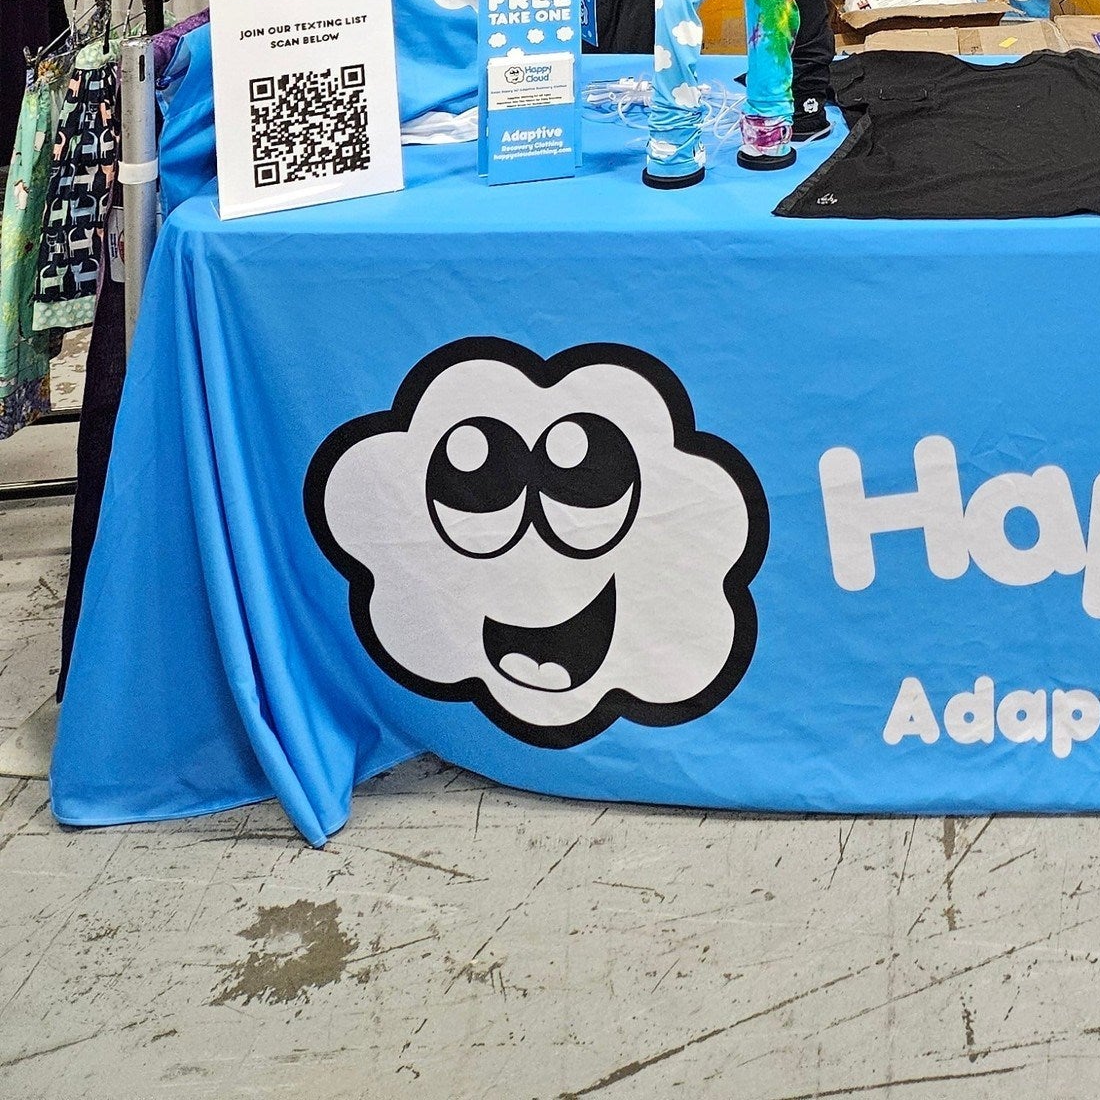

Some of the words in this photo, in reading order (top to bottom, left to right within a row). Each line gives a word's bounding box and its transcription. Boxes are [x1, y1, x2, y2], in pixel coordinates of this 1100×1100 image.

[488, 11, 531, 26] TAKE
[535, 8, 571, 23] ONE
[240, 28, 264, 40] JOIN
[268, 25, 291, 35] OUR
[294, 18, 342, 32] TEXTING
[345, 15, 367, 25] LIST
[270, 37, 299, 49] SCAN
[303, 32, 339, 45] BELOW
[524, 65, 552, 74] Happy
[525, 74, 550, 83] Cloud
[501, 126, 563, 143] Adaptive
[534, 140, 563, 148] Clothing
